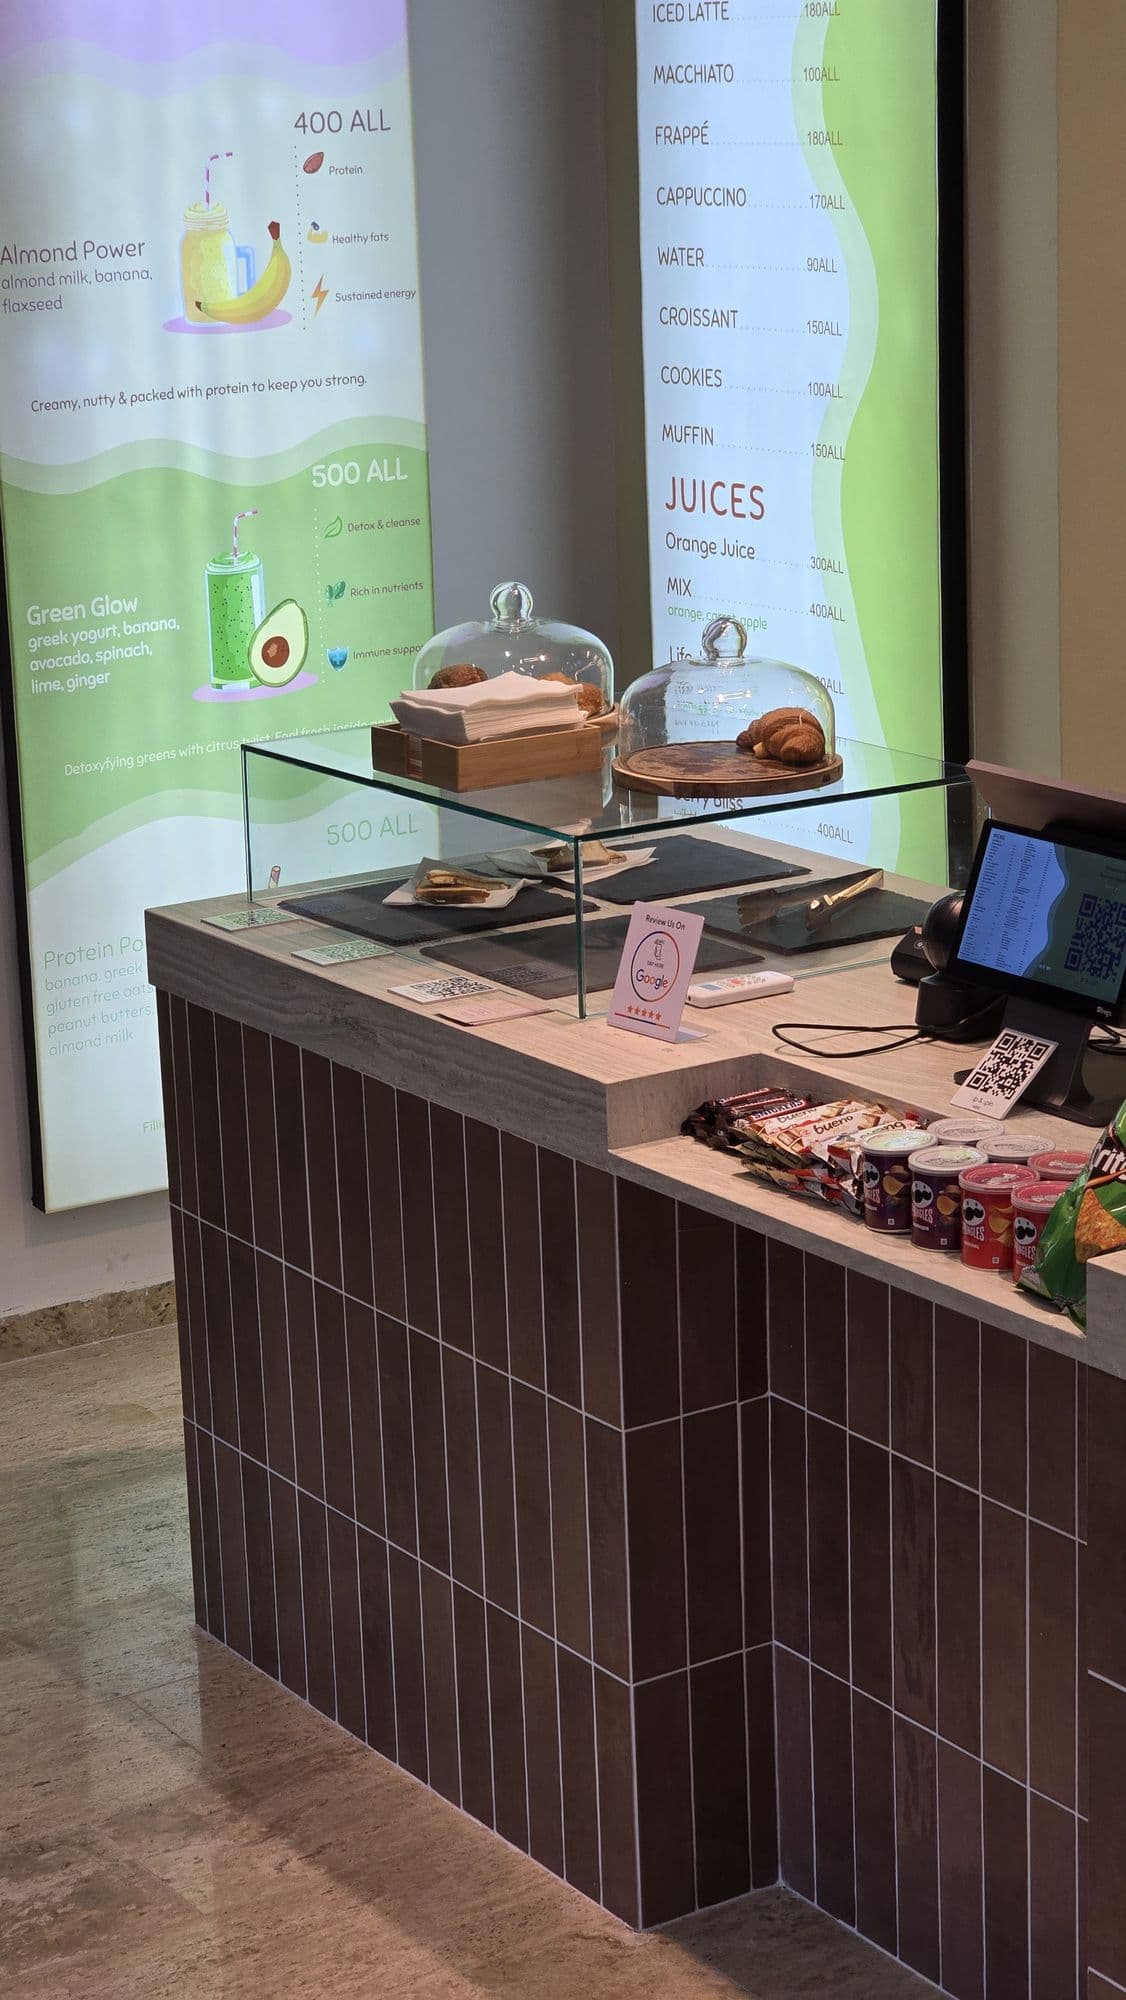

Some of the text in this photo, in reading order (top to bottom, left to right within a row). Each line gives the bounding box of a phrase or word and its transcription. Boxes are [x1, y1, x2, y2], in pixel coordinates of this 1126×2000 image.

[652, 1, 841, 23] ICED LATTE 180ALL
[653, 64, 840, 84] MACCHIATO 100ALL
[294, 108, 392, 135] 400 ALL
[655, 120, 843, 146] FRAPPÉ 180ALL
[328, 164, 363, 176] Protein
[656, 186, 845, 210] CAPPUCCINO 170ALL
[332, 231, 389, 246] Healthy fats
[0, 239, 145, 267] Almond Power
[657, 246, 838, 273] WATER 90ALL
[1, 273, 55, 290] almond
[2, 296, 63, 314] flaxseed
[335, 288, 416, 303] Sustained energy
[659, 306, 842, 336] CROISSANT 150ALL
[30, 374, 367, 413] Creamy, nutty & packed with protein to keep you strong.
[660, 366, 843, 399] COOKIES 100ALL
[662, 424, 845, 460] MUFFIN 150ALL
[312, 458, 408, 488] 500 ALL
[665, 476, 765, 520] JUICES
[347, 517, 421, 533] Detox & cleanse
[665, 532, 844, 573] Orange Juice 300ALL
[350, 581, 424, 598] Rich in nutrients
[667, 577, 846, 622] MIX 400ALL
[27, 595, 138, 626] Green Glow
[28, 632, 68, 653] greek
[71, 625, 120, 644] yogurt,
[95, 643, 153, 664] spinach,
[353, 644, 424, 660] Immune suppo
[31, 671, 111, 695] lime, ginger
[136, 748, 177, 766] greens
[179, 744, 204, 759] with
[327, 813, 418, 845] 500 ALL
[817, 822, 853, 843] 400ALL
[646, 914, 666, 926] Review
[668, 920, 675, 928] Us
[44, 936, 146, 969] Protein Po
[636, 969, 668, 990] Google
[46, 996, 90, 1016] gluten
[813, 1115, 854, 1135] bueno
